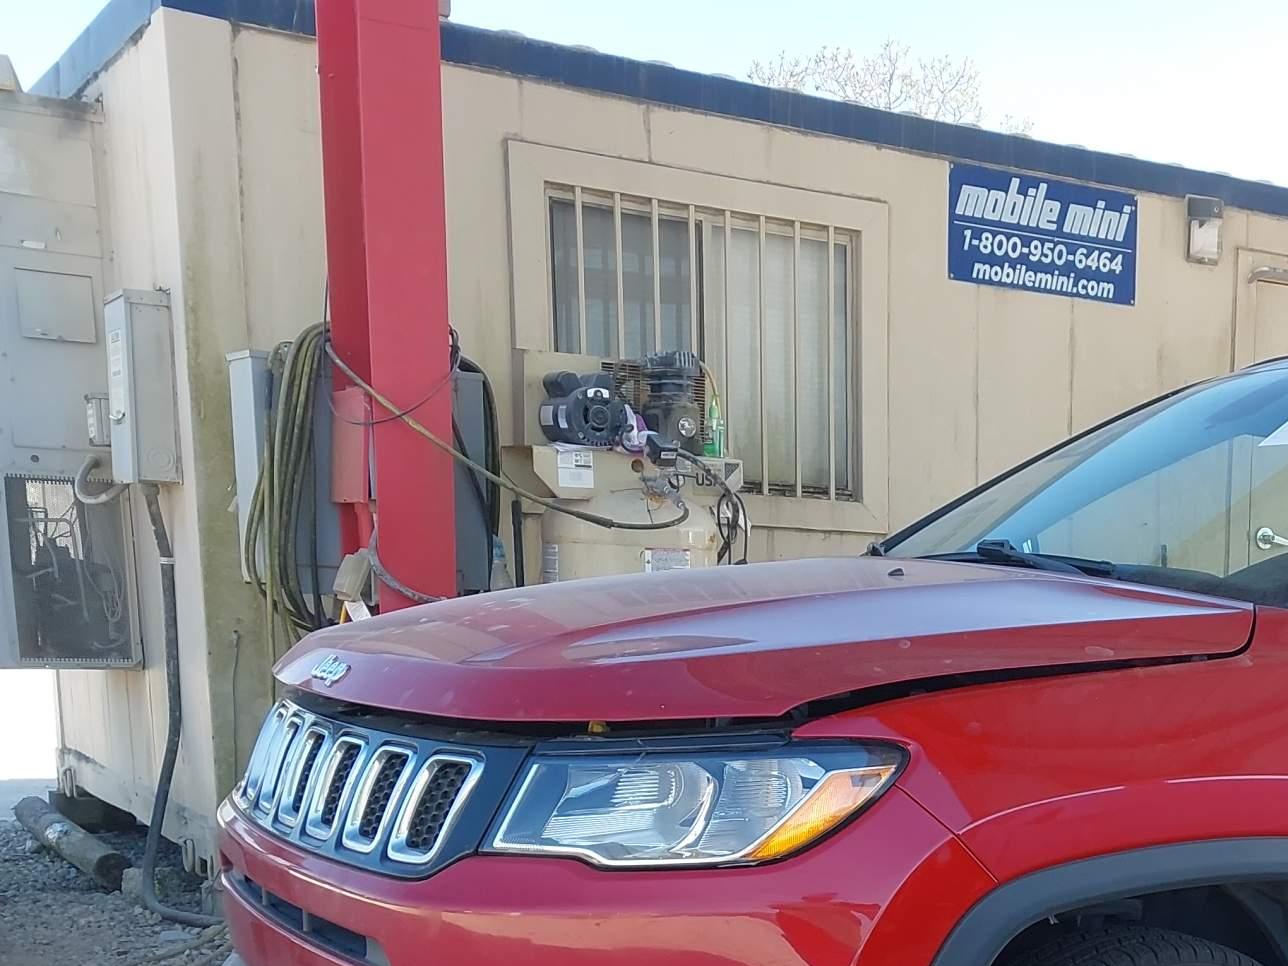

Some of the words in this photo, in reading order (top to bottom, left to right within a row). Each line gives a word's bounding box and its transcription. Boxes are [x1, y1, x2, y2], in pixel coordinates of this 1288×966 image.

[954, 177, 1062, 231] mobile
[1062, 200, 1132, 242] mini
[962, 229, 1123, 275] 1-800-950-6464
[971, 261, 1115, 299] mobilemini.com
[695, 472, 717, 487] US
